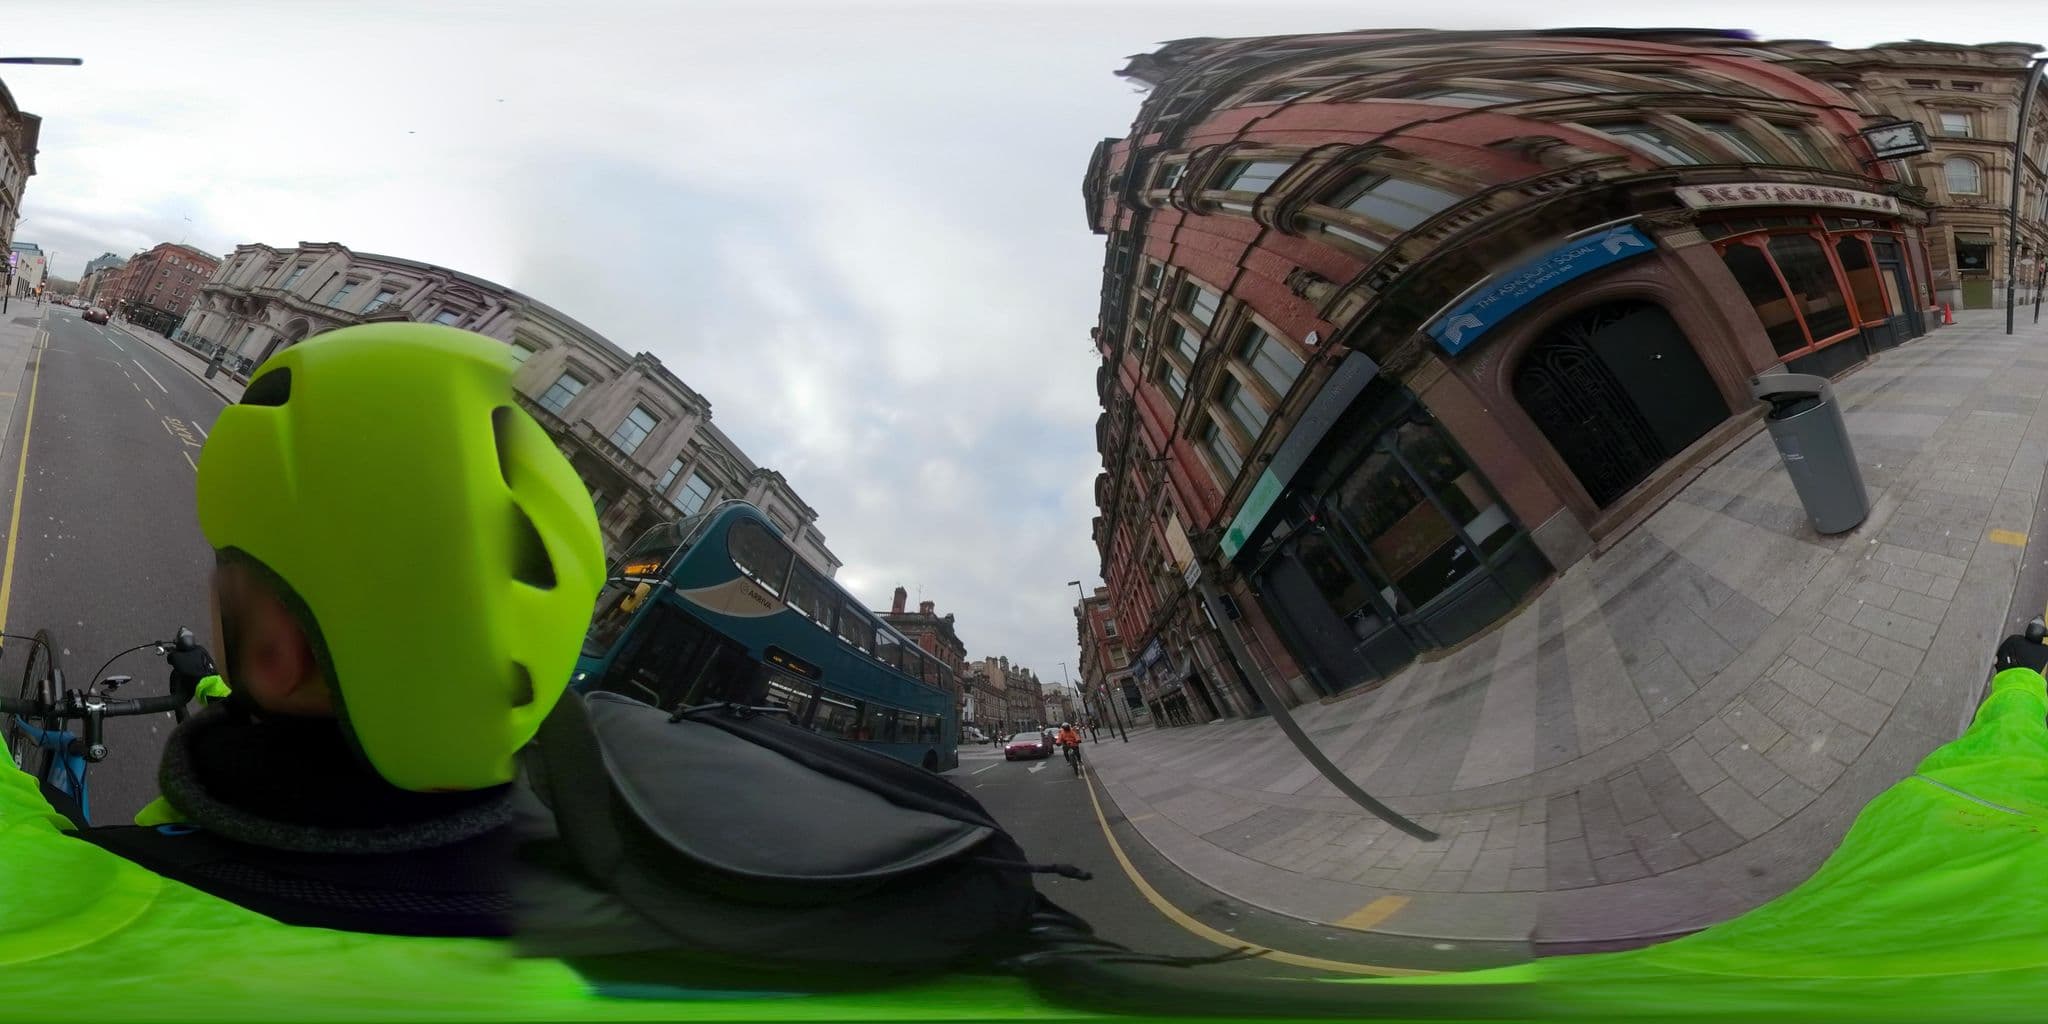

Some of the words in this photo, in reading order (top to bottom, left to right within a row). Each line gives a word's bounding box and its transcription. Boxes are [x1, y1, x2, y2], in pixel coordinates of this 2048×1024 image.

[1698, 185, 1855, 204] RESTAURANT
[1477, 294, 1497, 310] THE
[1554, 246, 1596, 264] SOCIAL
[748, 590, 772, 609] ARRIVA
